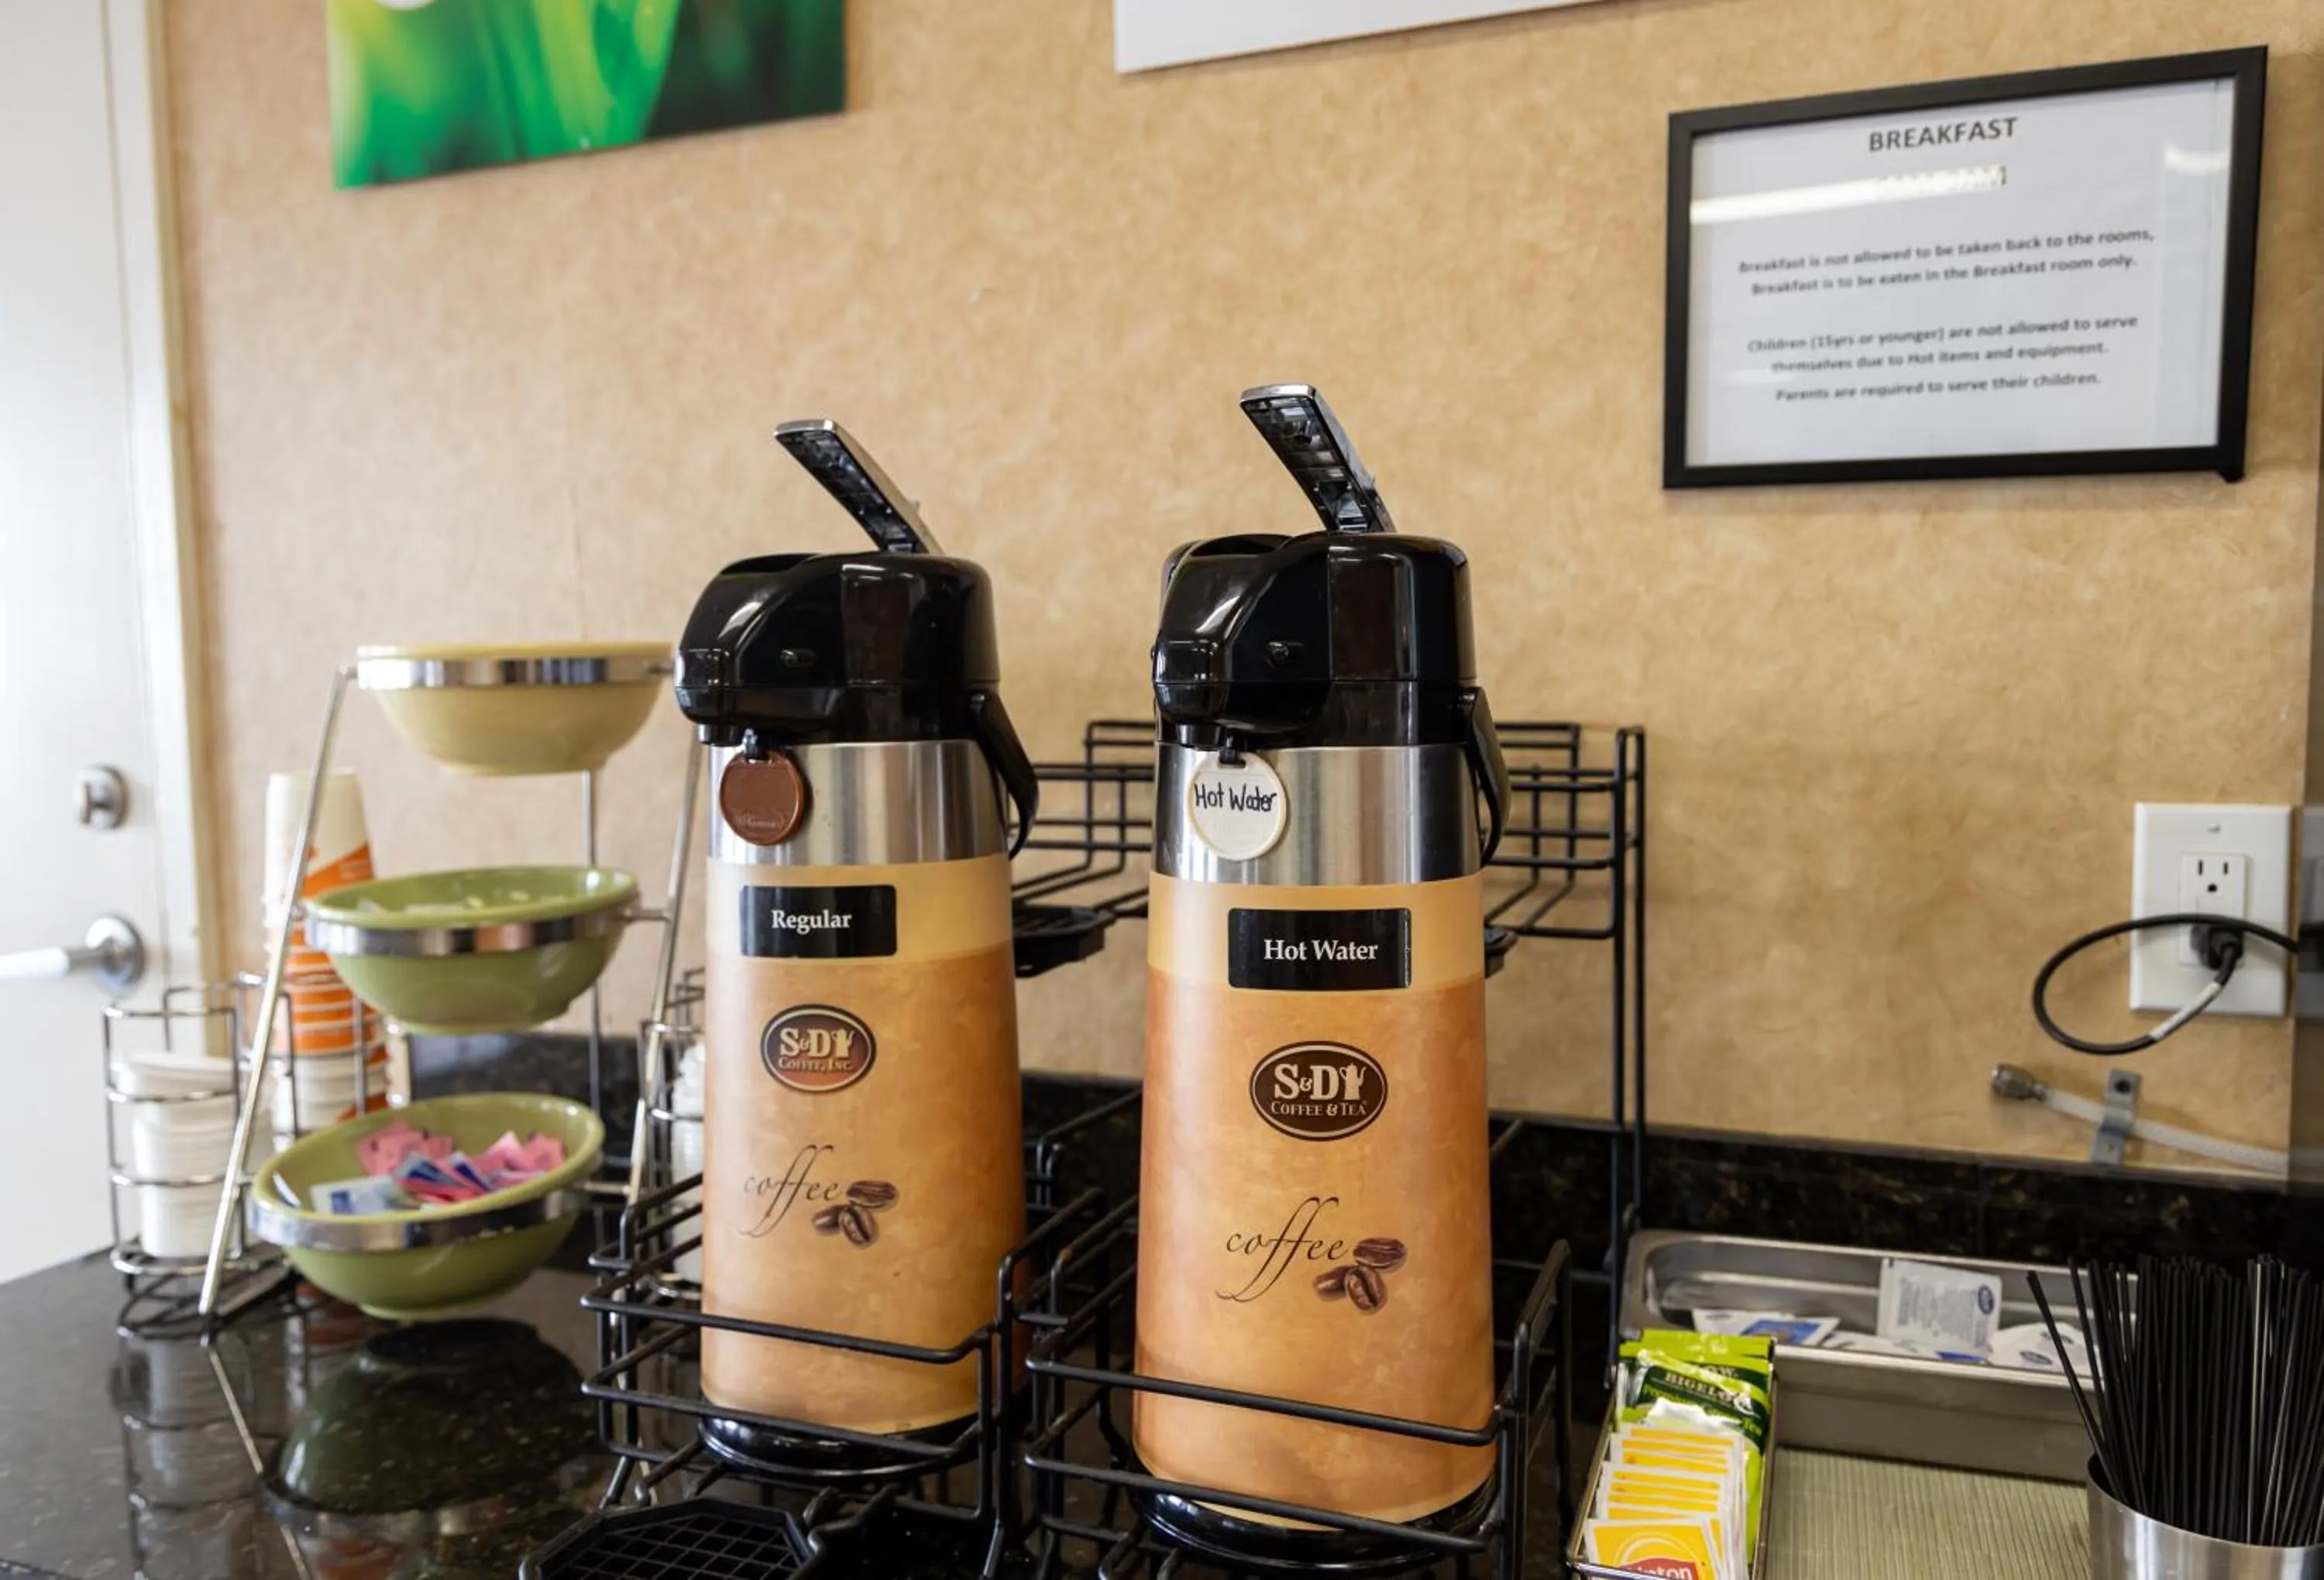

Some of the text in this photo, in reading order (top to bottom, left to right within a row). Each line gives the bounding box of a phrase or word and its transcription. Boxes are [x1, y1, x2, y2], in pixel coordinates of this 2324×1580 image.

[1869, 116, 2018, 153] BREAKFAST
[1738, 257, 1805, 273] Breakfast
[1809, 256, 1820, 267] is
[1824, 253, 1849, 266] not
[1853, 247, 1911, 264] allowed
[1915, 247, 1931, 259] to
[1935, 245, 1954, 257] be
[1958, 240, 2002, 255] taken
[2005, 235, 2042, 251] back
[2046, 235, 2064, 248] to
[2067, 232, 2094, 246] the
[1752, 279, 1818, 296] Breakfast
[1822, 279, 1834, 289] is
[1838, 276, 1853, 288] to
[1857, 275, 1875, 287] be
[1879, 272, 1922, 285] eaten
[1925, 269, 1940, 281] in
[1943, 266, 1968, 280] the
[1973, 260, 2046, 278] Breakfast
[2051, 258, 2094, 271] room
[1748, 338, 1807, 352] Children
[1858, 334, 1874, 345] or
[1948, 328, 1973, 339] are
[1976, 323, 2003, 337] not
[2007, 318, 2071, 335] allowed
[2073, 318, 2092, 331] to
[2094, 316, 2138, 330] serve
[1856, 356, 1884, 369] due
[1887, 355, 1904, 366] to
[1984, 345, 2014, 360] and
[1776, 388, 1829, 401] Parents
[1833, 387, 1857, 398] are
[1861, 380, 1924, 397] required
[1927, 381, 1944, 393] to
[1948, 380, 1988, 392] serve
[1992, 375, 2029, 390] their
[1194, 781, 1277, 812] Hot Water
[771, 909, 852, 935] Regular
[1263, 939, 1379, 961] Hot Water
[779, 1027, 832, 1058] S&D
[1274, 1063, 1340, 1100] S&D
[1325, 1103, 1339, 1117] &
[738, 1144, 843, 1238] coffee
[1215, 1197, 1349, 1303] coffee
